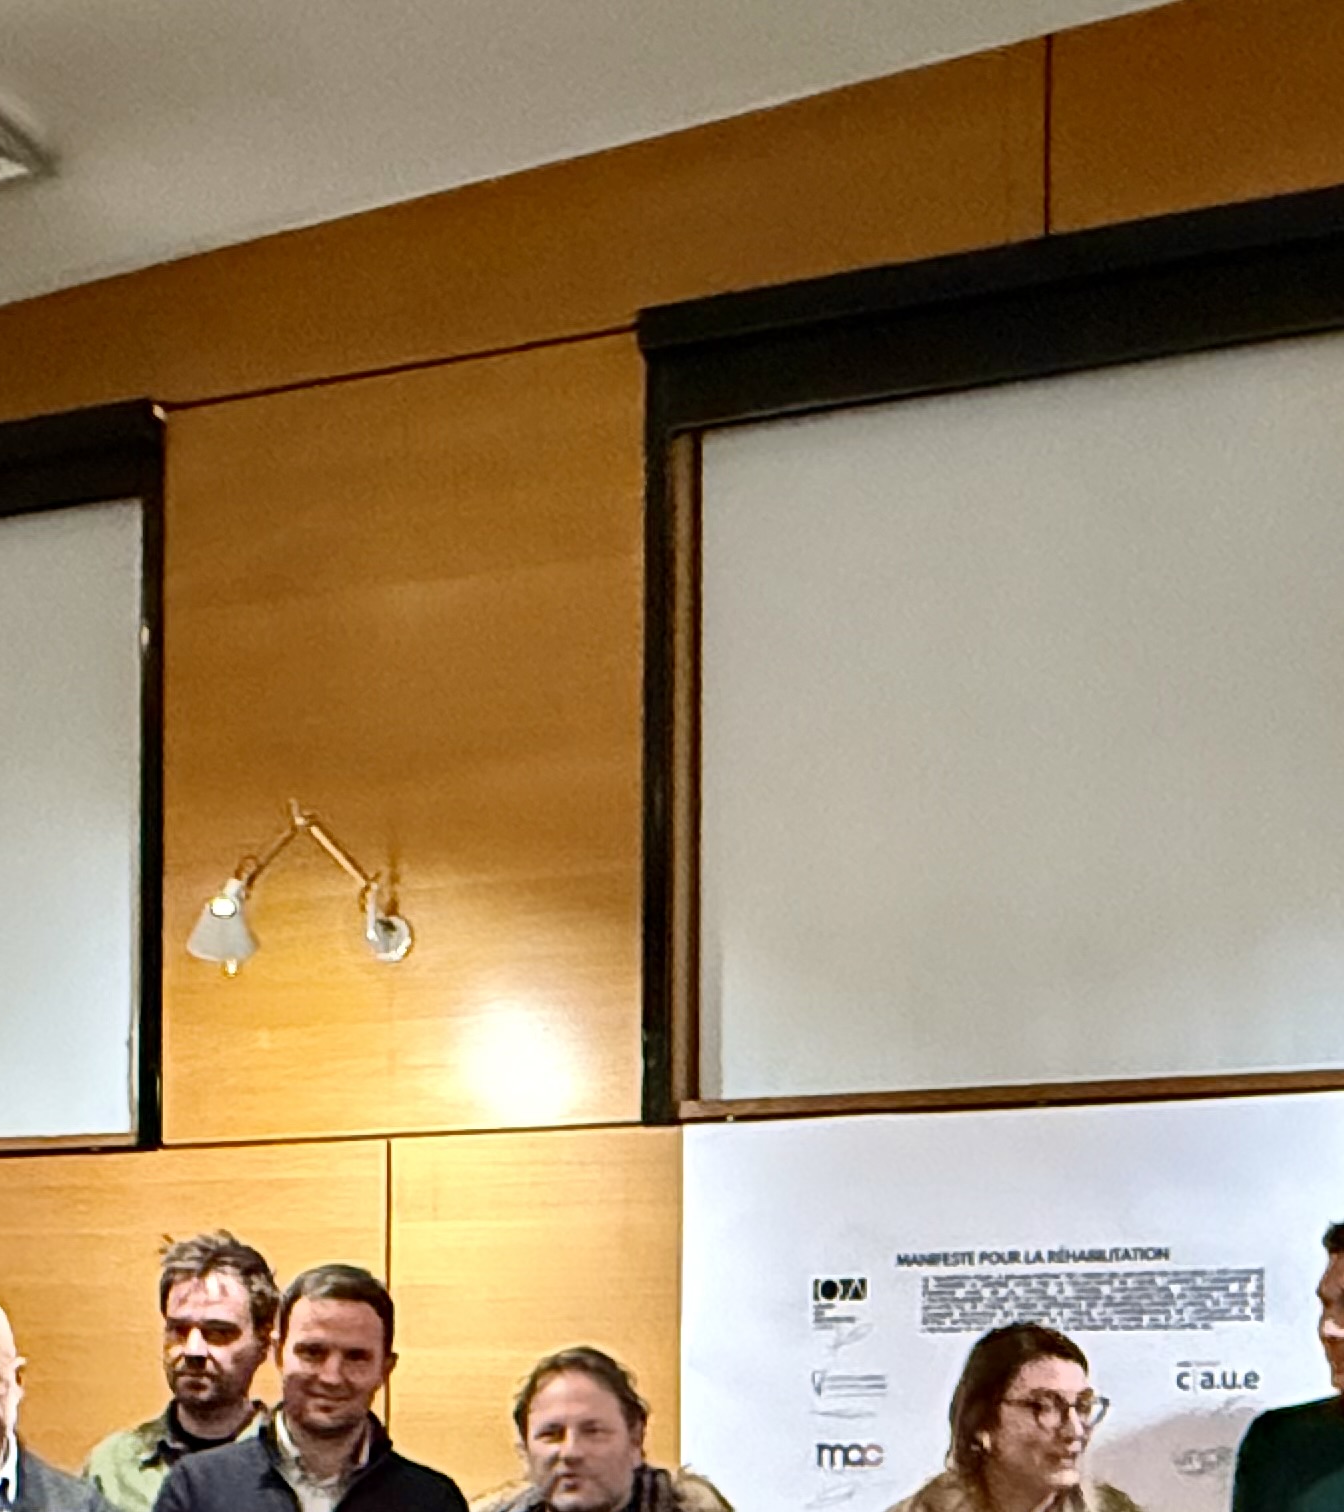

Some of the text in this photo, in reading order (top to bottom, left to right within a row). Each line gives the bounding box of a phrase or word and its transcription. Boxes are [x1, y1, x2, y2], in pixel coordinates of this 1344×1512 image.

[896, 1245, 1170, 1268] MANIFESTE POUR LA RÉHABILITATION
